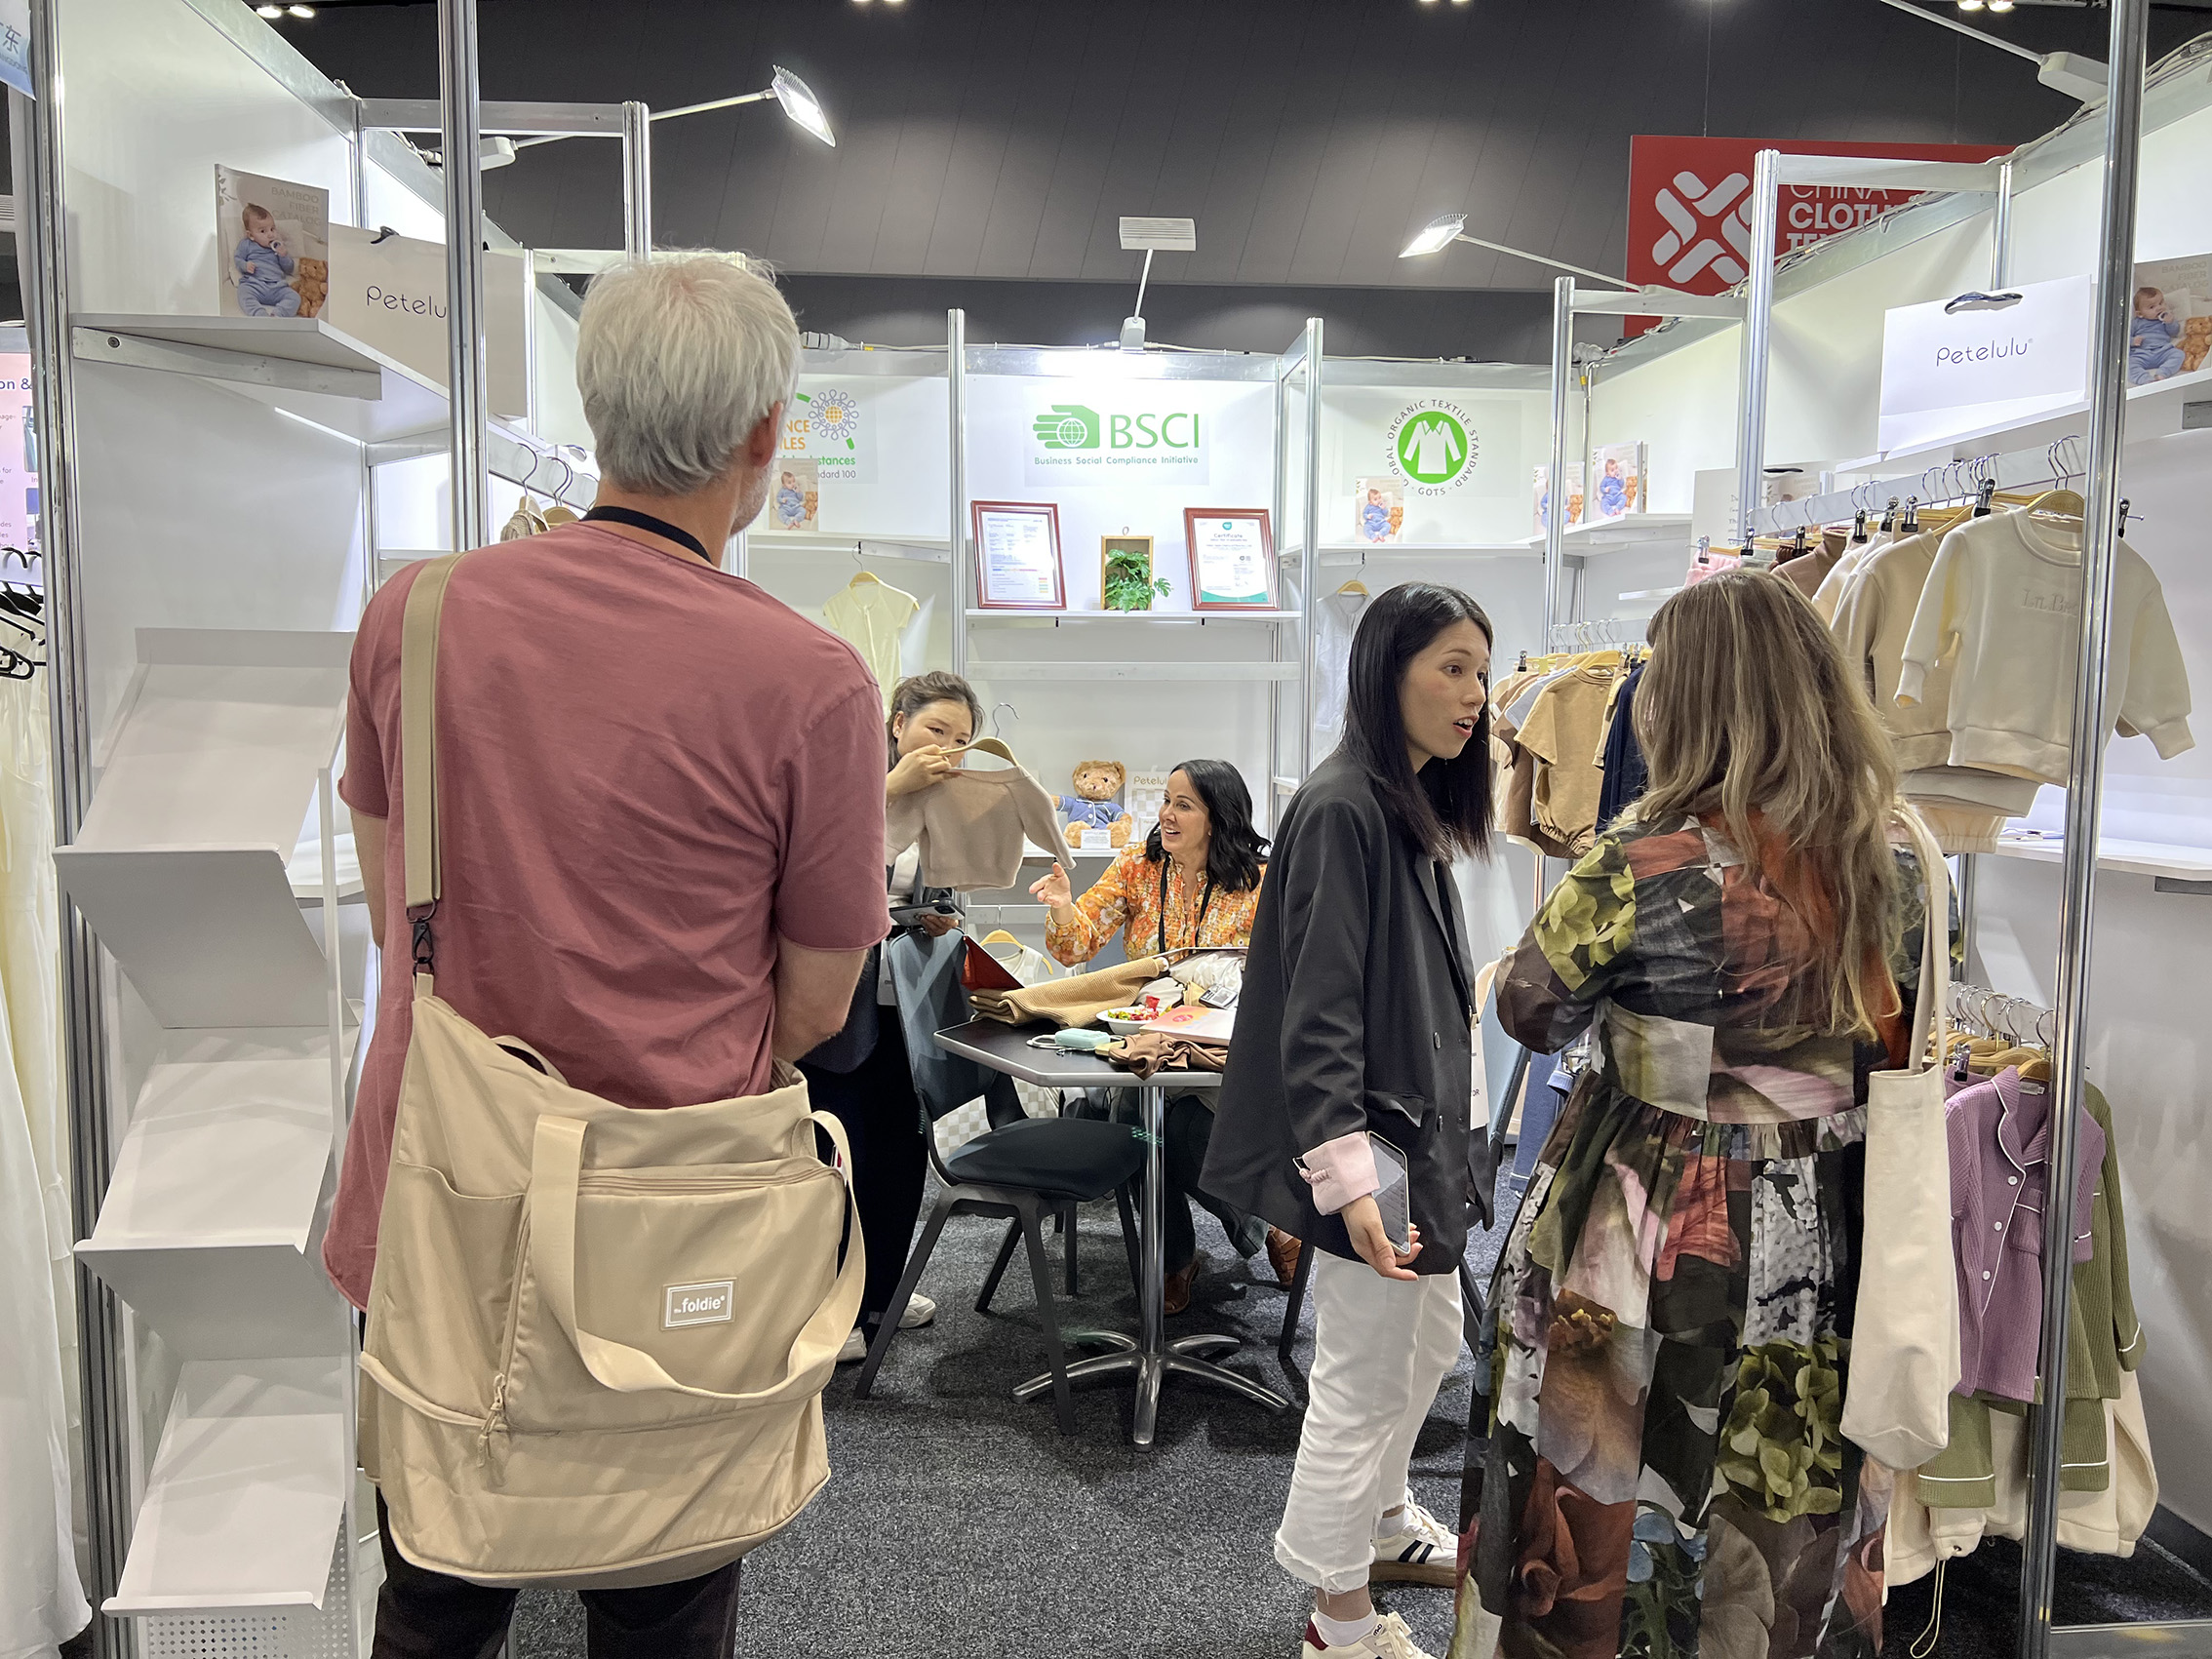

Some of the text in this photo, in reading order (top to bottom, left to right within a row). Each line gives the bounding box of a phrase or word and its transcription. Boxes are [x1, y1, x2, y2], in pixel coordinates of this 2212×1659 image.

[271, 186, 319, 204] BAMBOO
[272, 209, 321, 226] CATALOG
[290, 203, 319, 215] FIBER
[367, 285, 447, 319] Petelu
[1387, 400, 1425, 440] ORGANIC
[1431, 399, 1472, 426] TEXTILE
[1110, 413, 1200, 450] BSCI
[818, 455, 855, 465] stances
[1034, 456, 1072, 465] Business
[1106, 456, 1158, 465] Compliance
[1161, 455, 1199, 464] Initiative
[1454, 429, 1480, 488] STANDARD
[819, 470, 840, 479] dard
[1417, 487, 1446, 496] GOTS
[1133, 775, 1167, 785] Petelul
